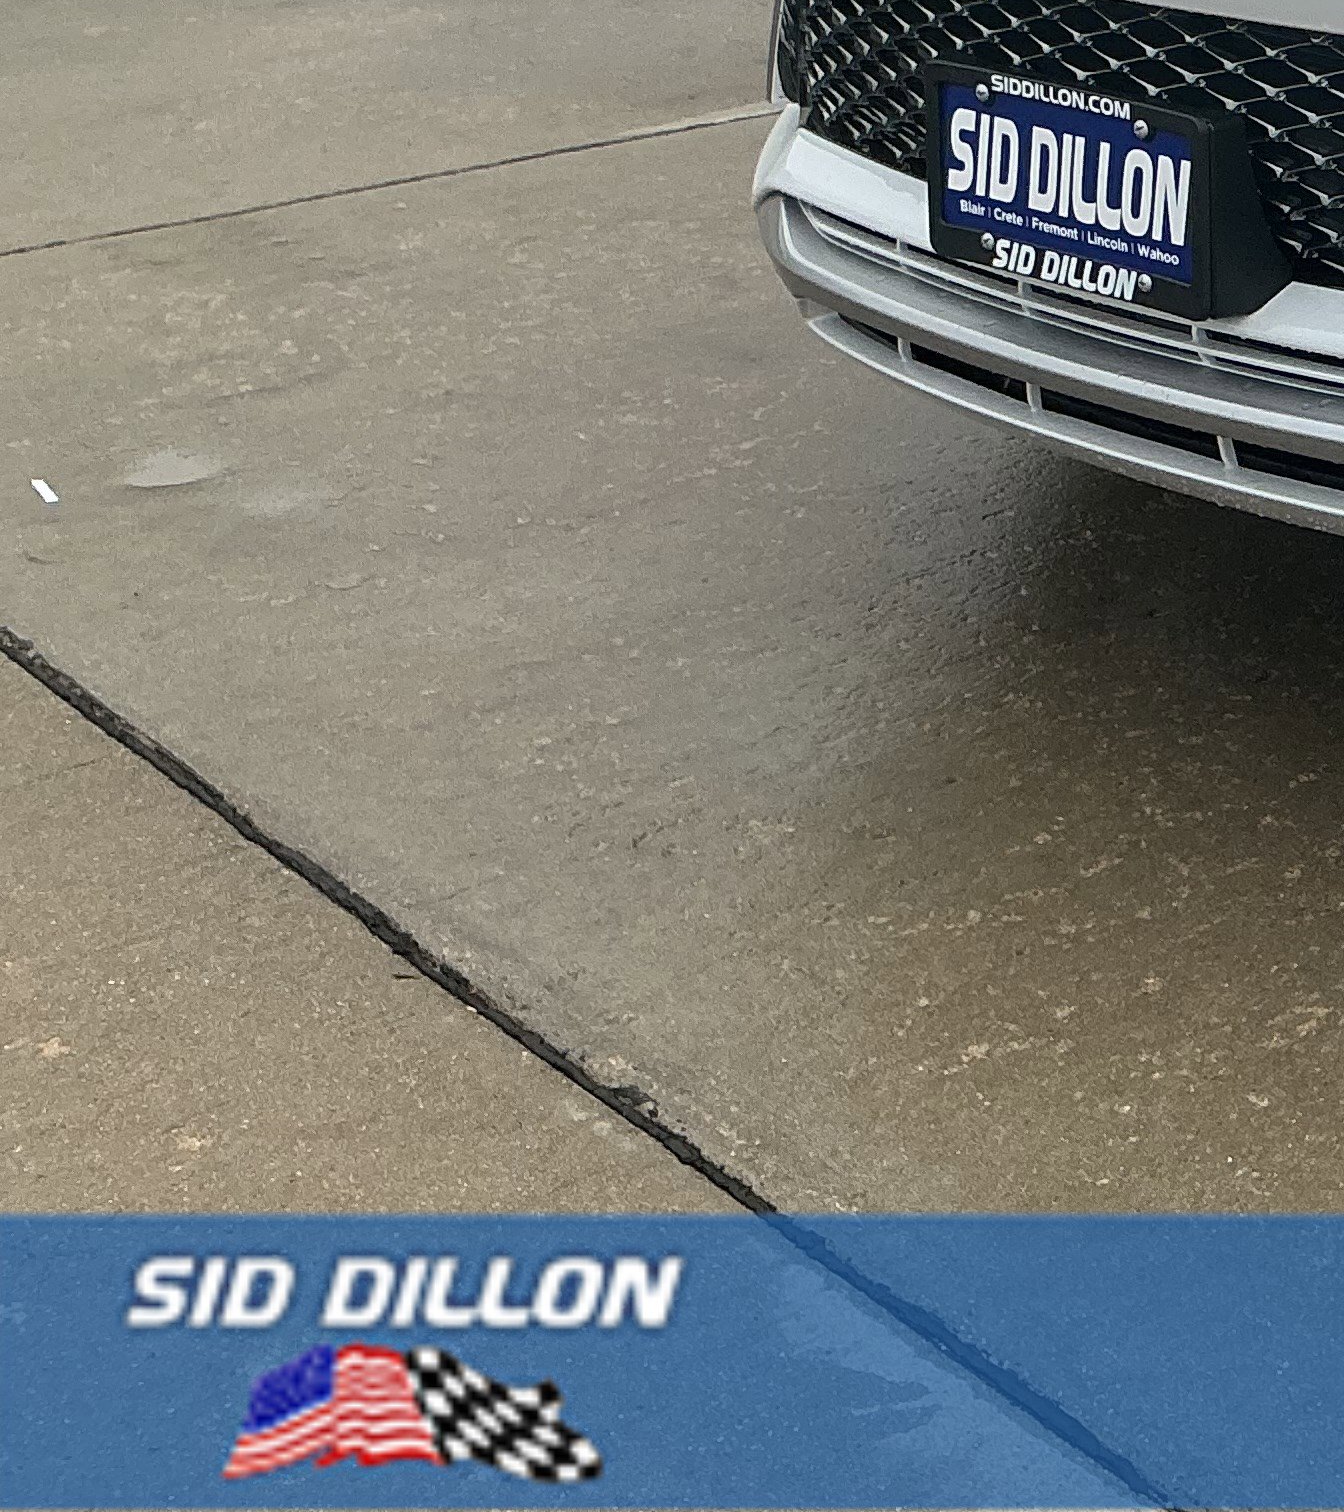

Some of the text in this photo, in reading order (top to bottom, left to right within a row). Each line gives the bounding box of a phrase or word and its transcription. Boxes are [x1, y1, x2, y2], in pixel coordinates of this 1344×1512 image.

[990, 74, 1131, 120] SIDDILLON.COM
[947, 107, 1191, 247] SID DILLON
[960, 199, 1180, 266] Blair Crete Fremont Lincoln Wahoo
[992, 238, 1138, 301] SID DILLON
